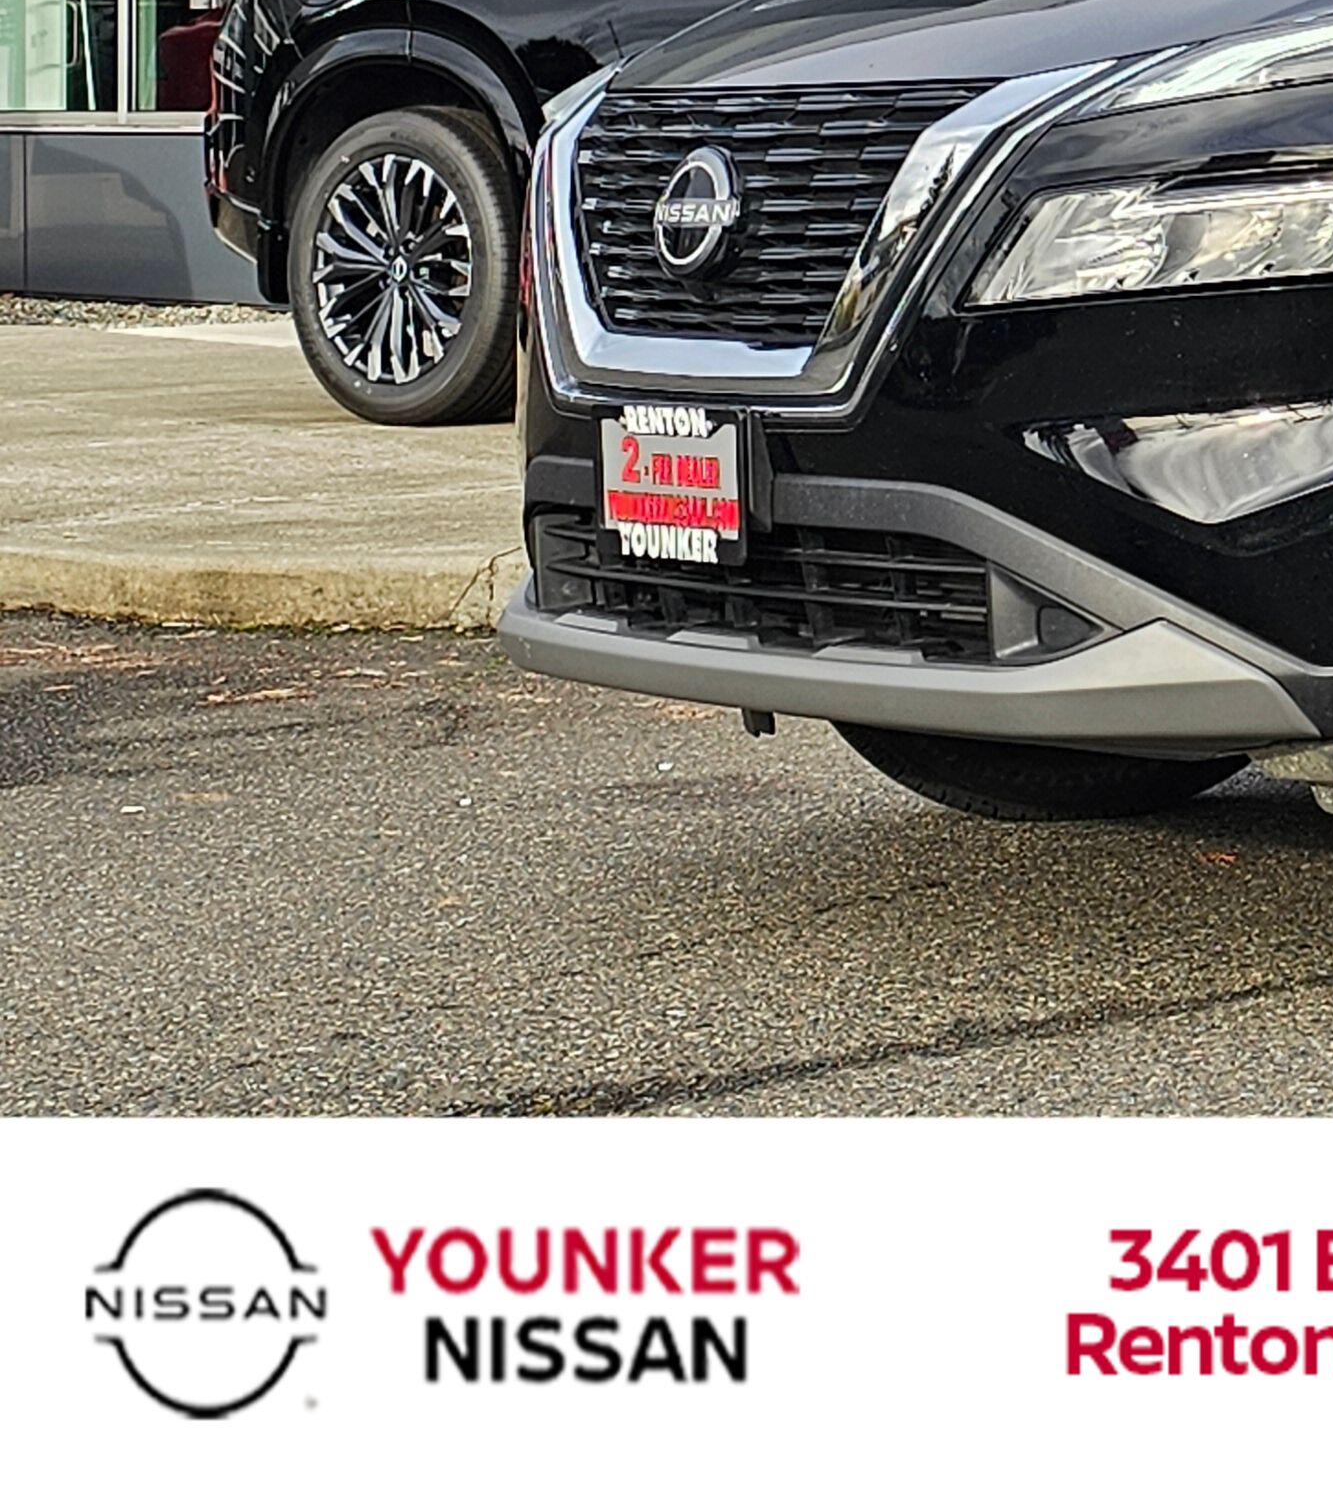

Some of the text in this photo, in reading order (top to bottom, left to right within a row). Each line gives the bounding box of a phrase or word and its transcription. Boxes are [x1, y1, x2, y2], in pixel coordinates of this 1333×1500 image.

[656, 202, 732, 223] NISSAN
[622, 405, 708, 439] RENTON
[618, 521, 719, 564] YOUNKER
